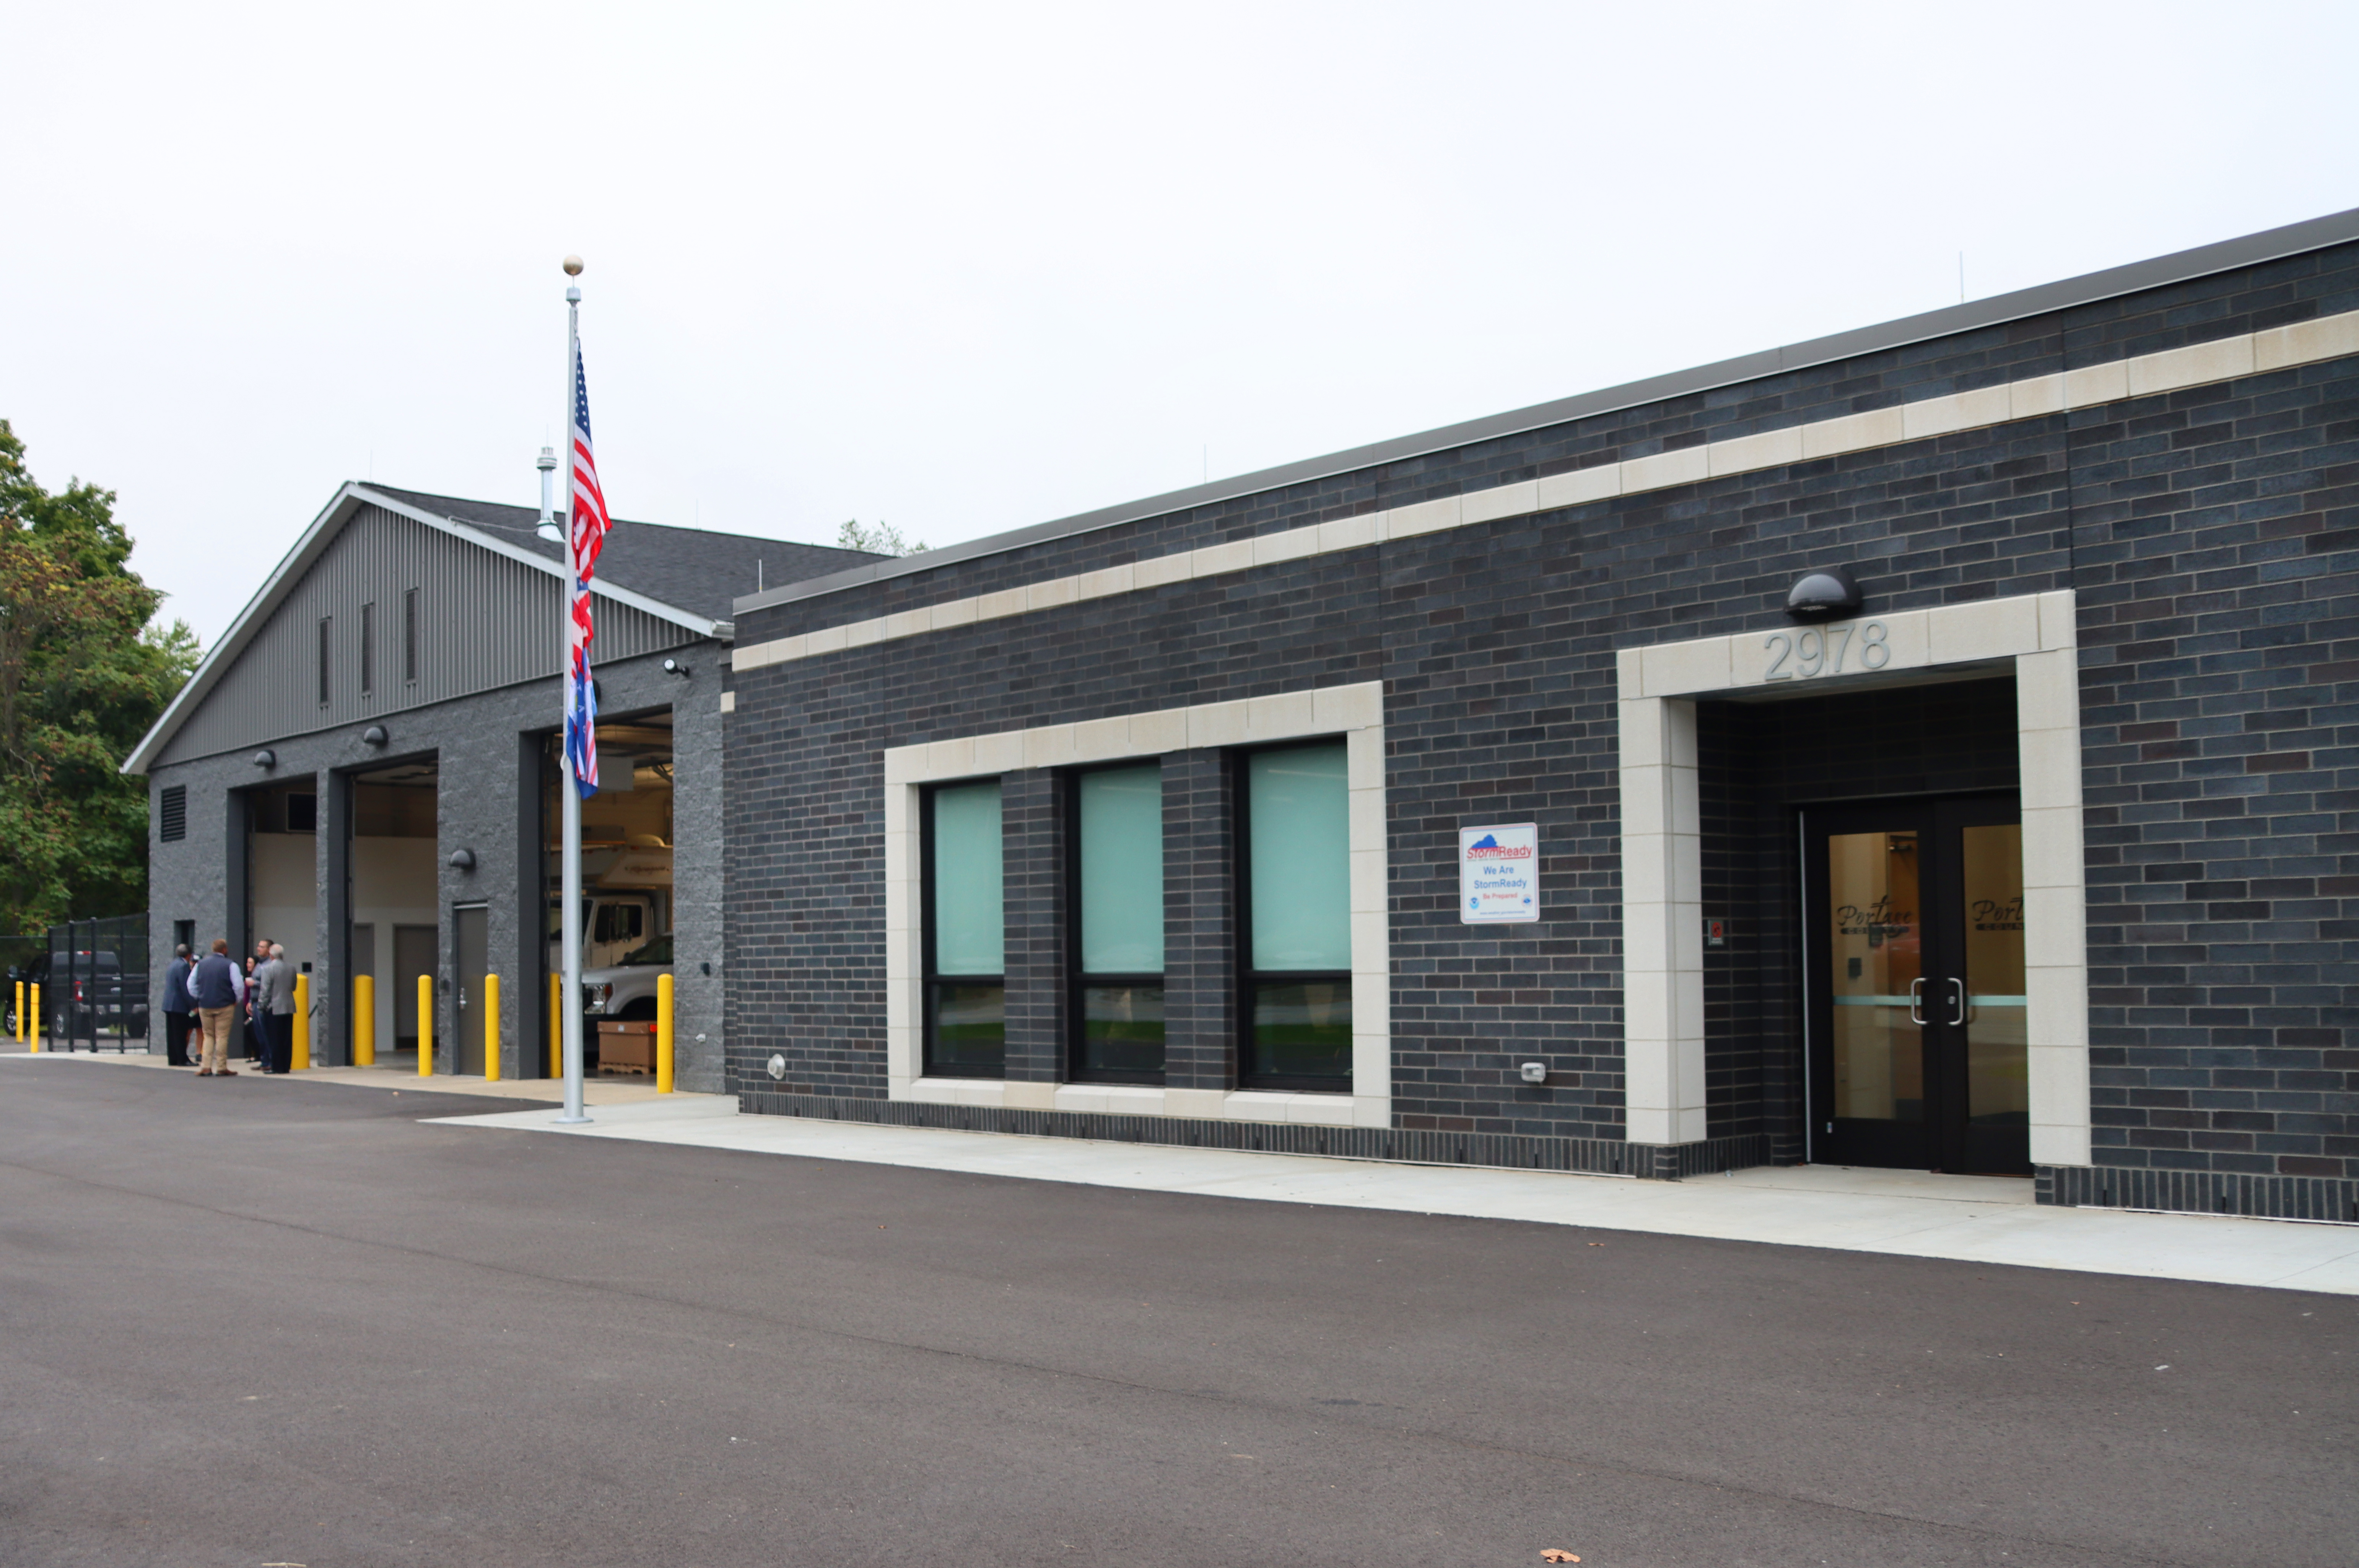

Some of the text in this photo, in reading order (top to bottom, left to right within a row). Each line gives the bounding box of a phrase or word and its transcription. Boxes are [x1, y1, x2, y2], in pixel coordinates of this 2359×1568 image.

[1764, 620, 1890, 681] 2978
[1467, 844, 1532, 859] StormReady
[1484, 866, 1496, 875] We
[1474, 878, 1527, 889] StormReady
